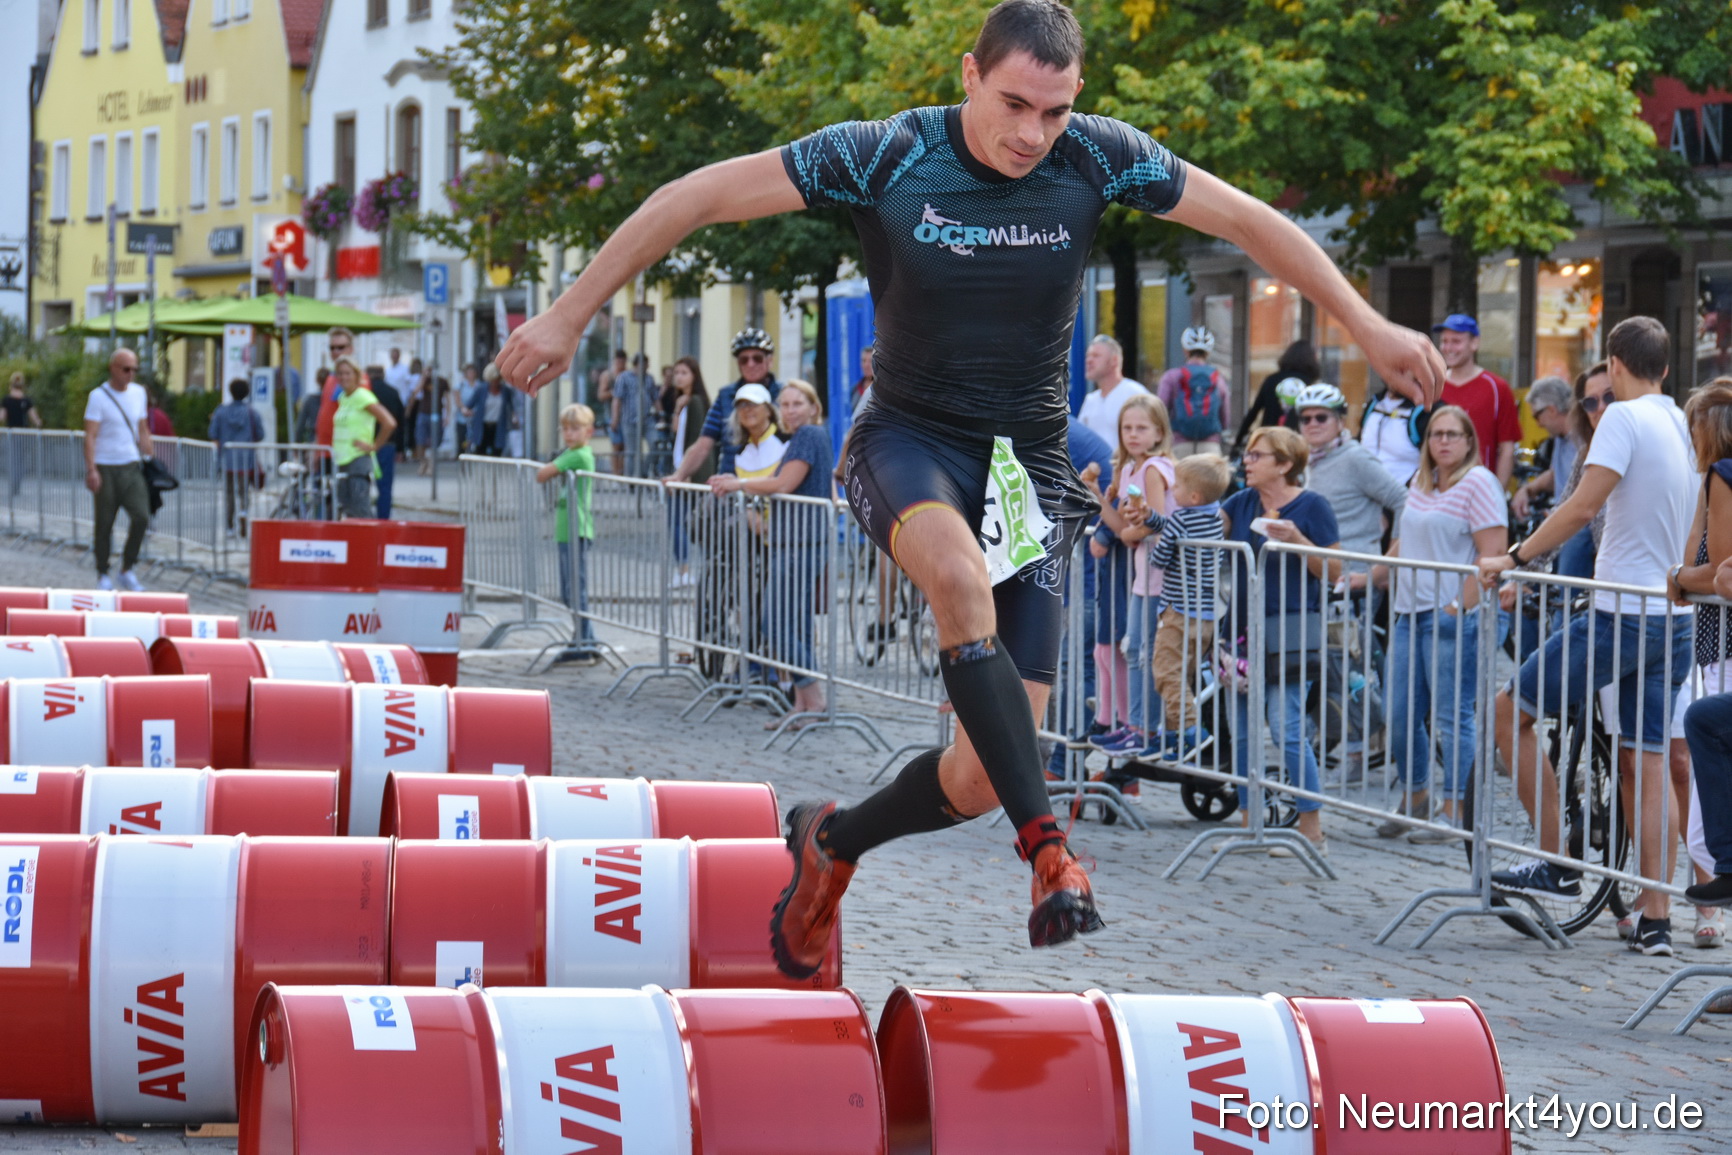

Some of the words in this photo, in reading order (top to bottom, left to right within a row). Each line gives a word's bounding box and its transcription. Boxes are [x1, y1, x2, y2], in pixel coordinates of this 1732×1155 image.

[97, 90, 130, 123] HOTEL
[429, 268, 444, 298] P
[249, 604, 277, 632] VIA
[149, 734, 162, 768] RO
[373, 995, 398, 1029] RO
[539, 1044, 623, 1155] VIA
[1176, 1021, 1271, 1155] AVI
